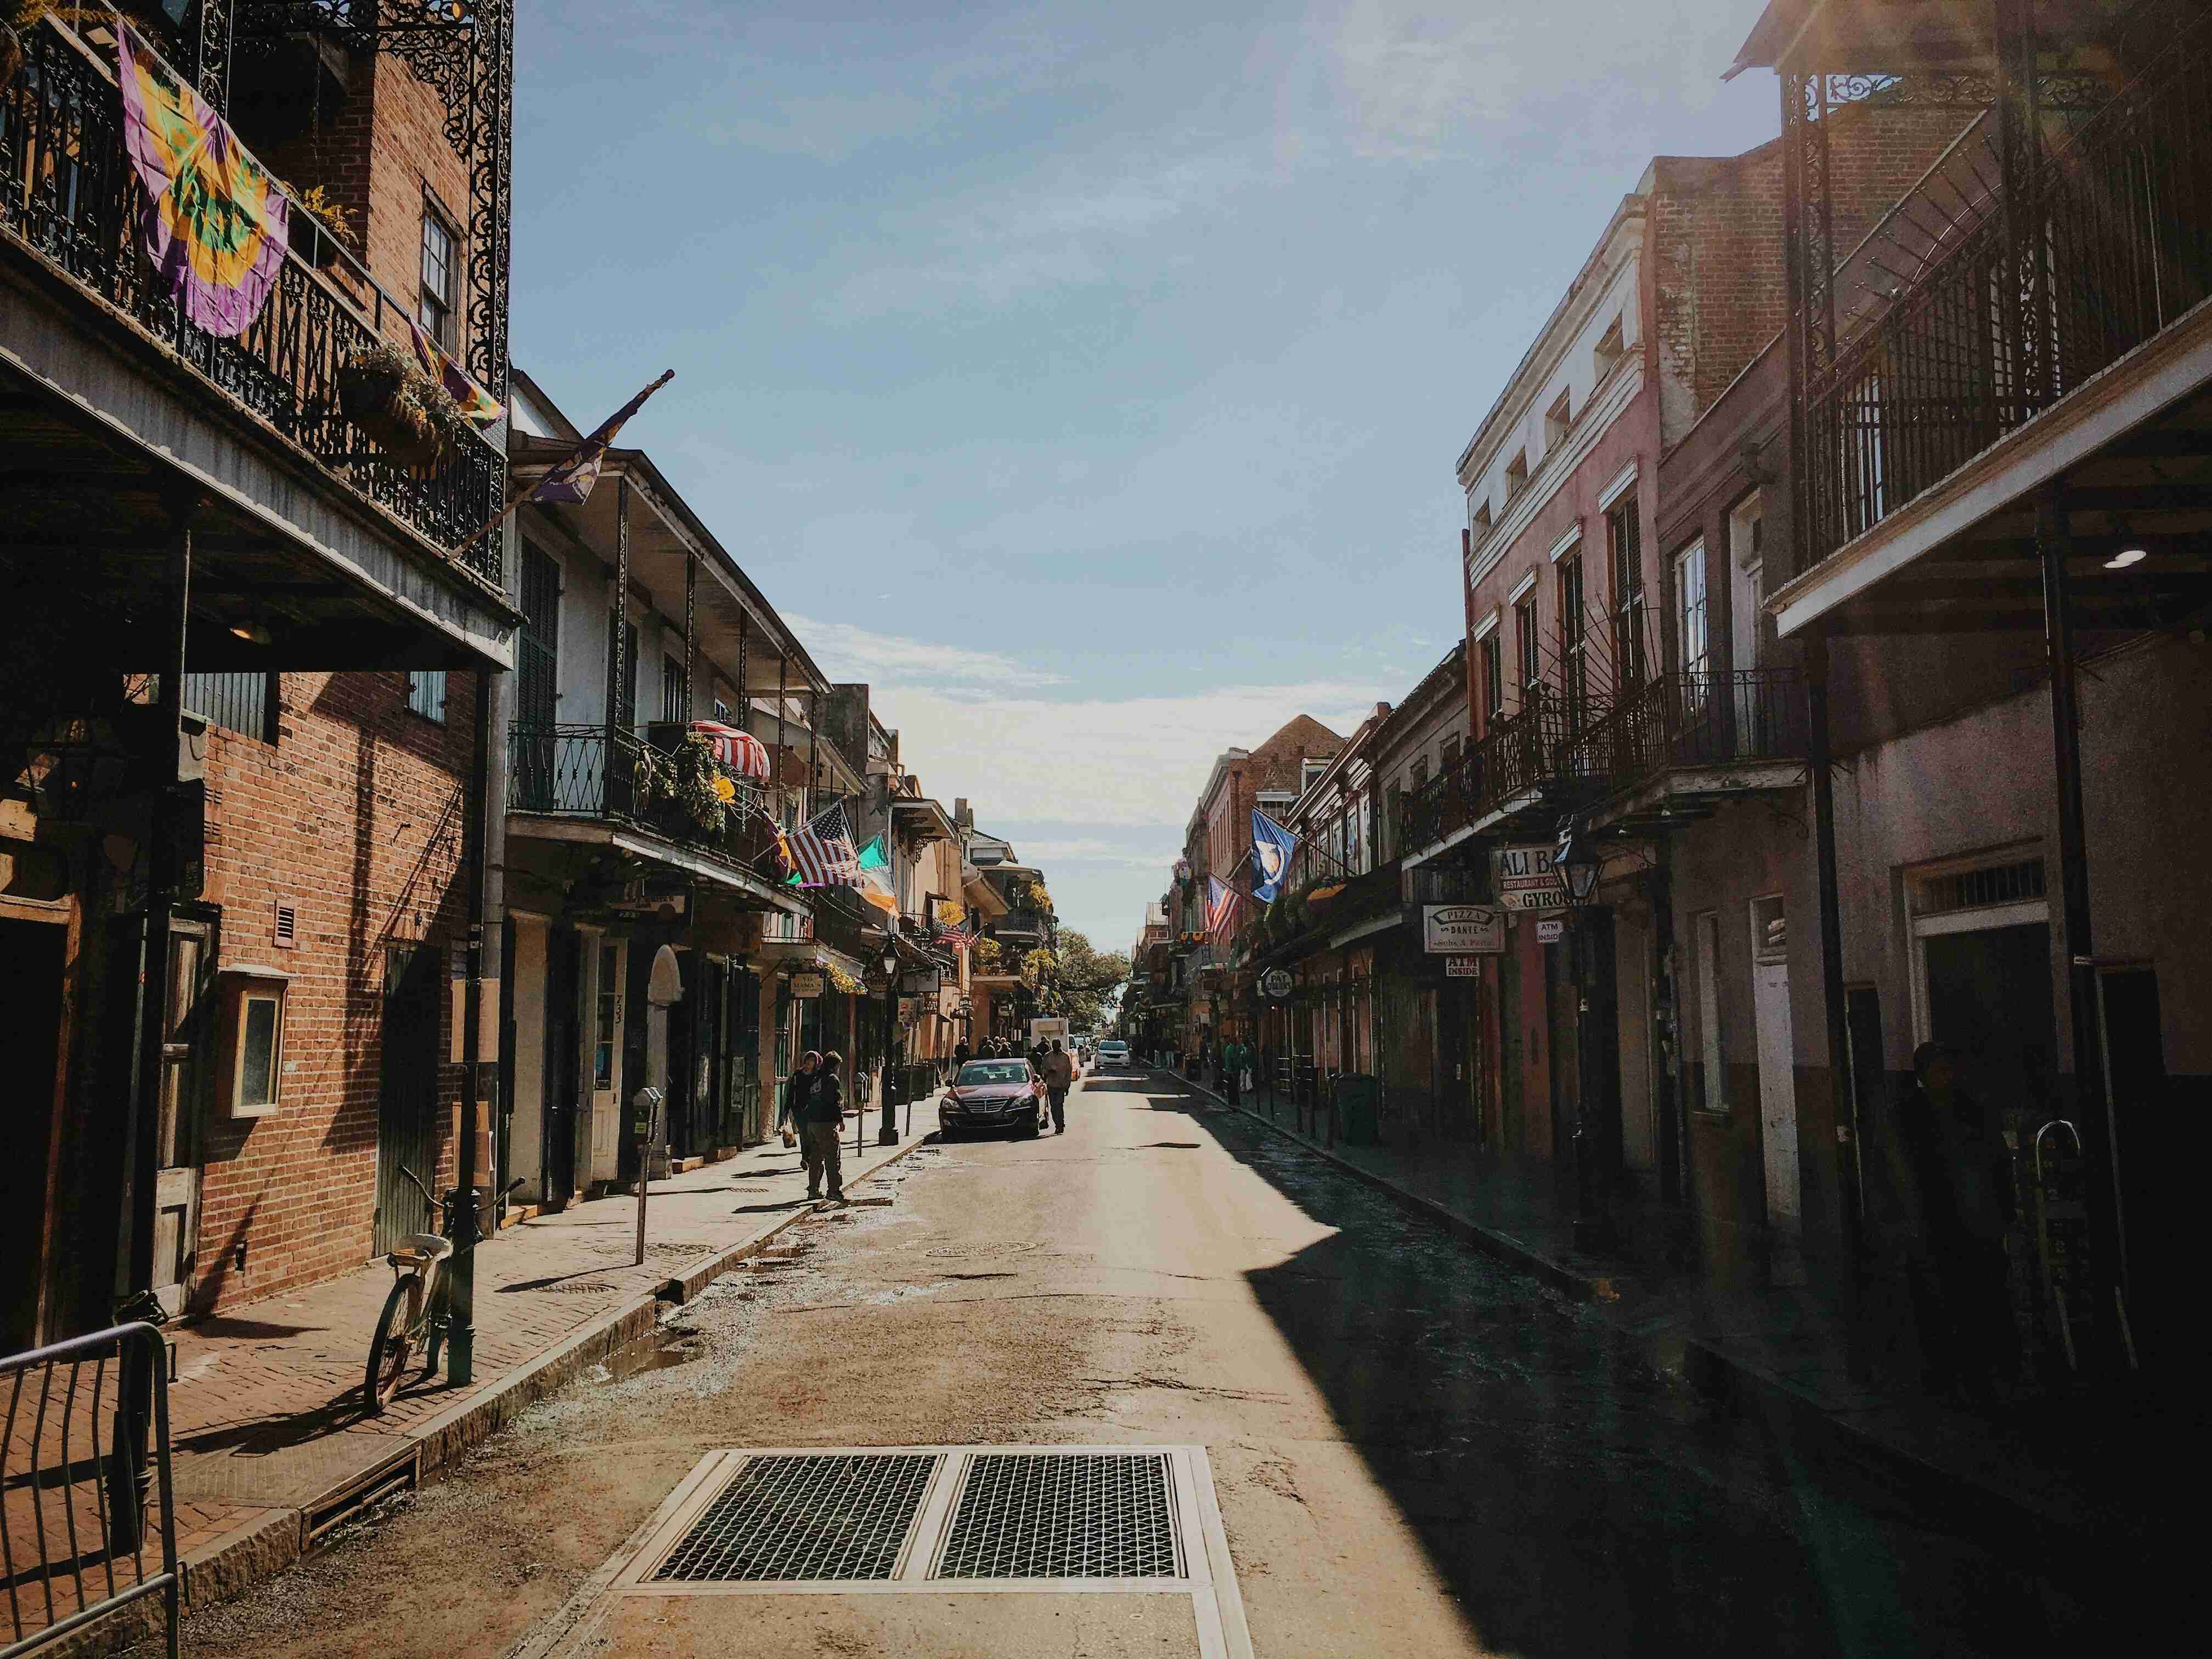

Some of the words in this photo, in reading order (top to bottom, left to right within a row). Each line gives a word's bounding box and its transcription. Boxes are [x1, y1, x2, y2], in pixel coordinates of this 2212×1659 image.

[1500, 851, 1530, 876] ALI
[1503, 878, 1539, 889] RESTAURANT
[1448, 911, 1482, 919] PIZZA
[1448, 956, 1477, 967] ATM
